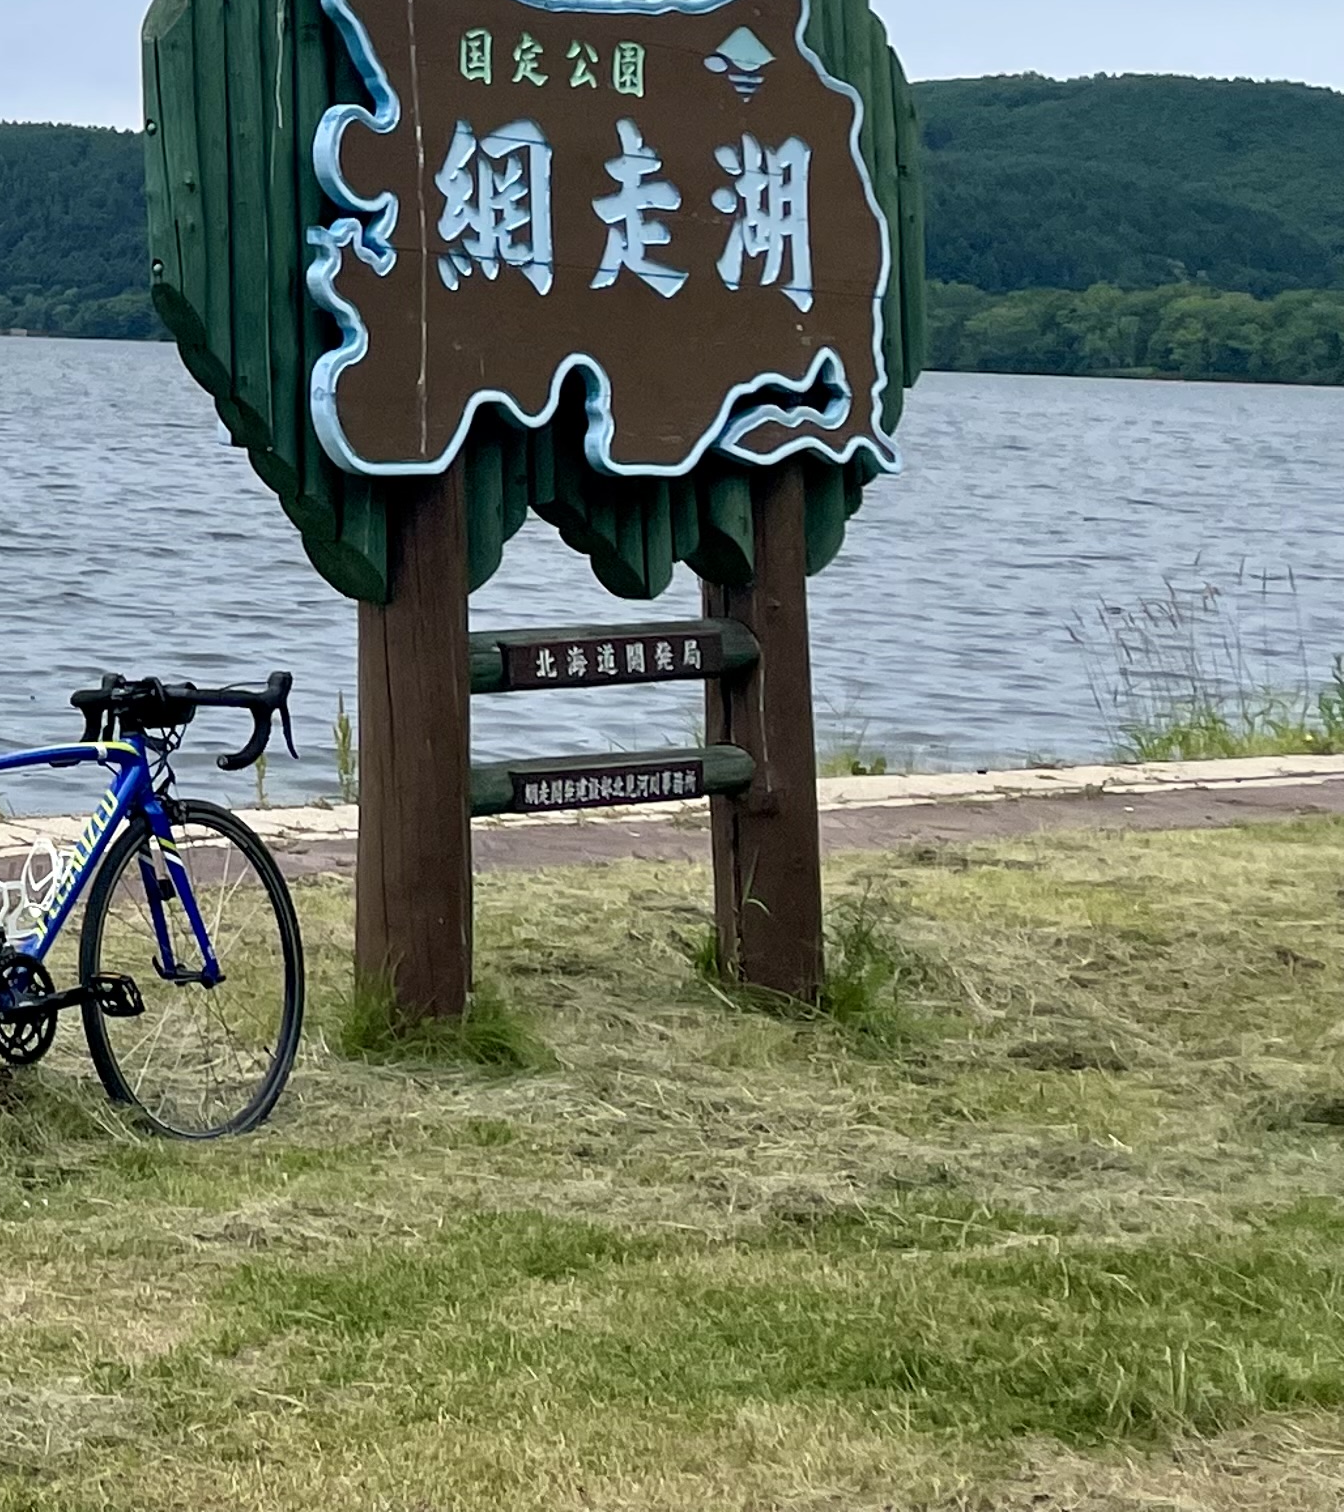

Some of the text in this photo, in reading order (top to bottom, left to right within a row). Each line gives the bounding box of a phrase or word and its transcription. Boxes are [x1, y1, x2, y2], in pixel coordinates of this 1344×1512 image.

[459, 26, 646, 98] 国定公園
[434, 115, 814, 313] 網走湖
[535, 639, 702, 678] 北海道開発局
